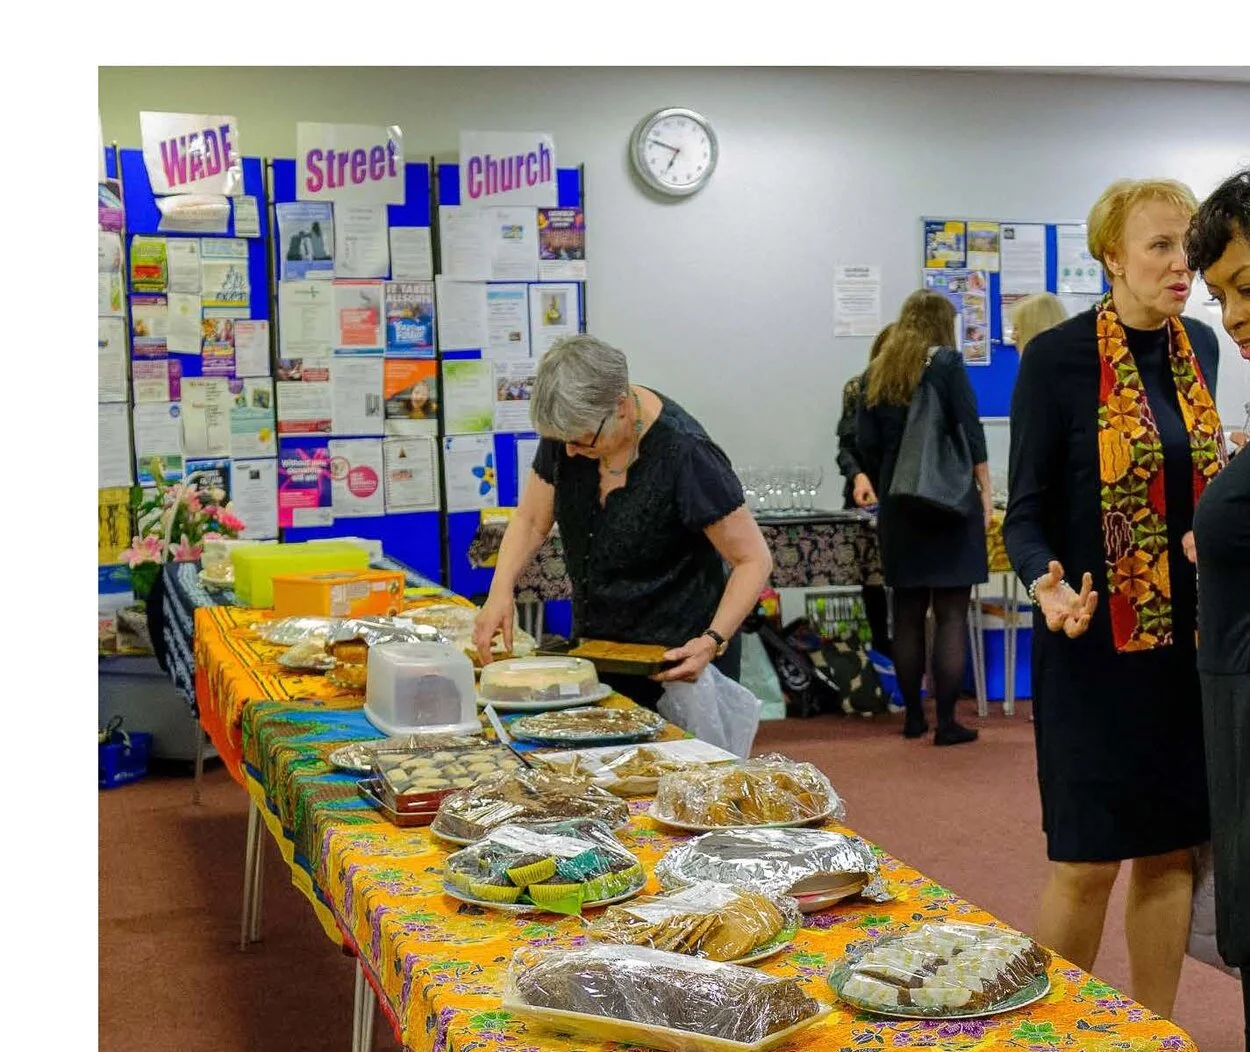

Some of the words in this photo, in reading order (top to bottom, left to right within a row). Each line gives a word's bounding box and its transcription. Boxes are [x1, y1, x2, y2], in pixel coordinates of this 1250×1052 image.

[160, 123, 235, 188] WADE
[306, 138, 397, 193] Street
[468, 142, 552, 199] Church
